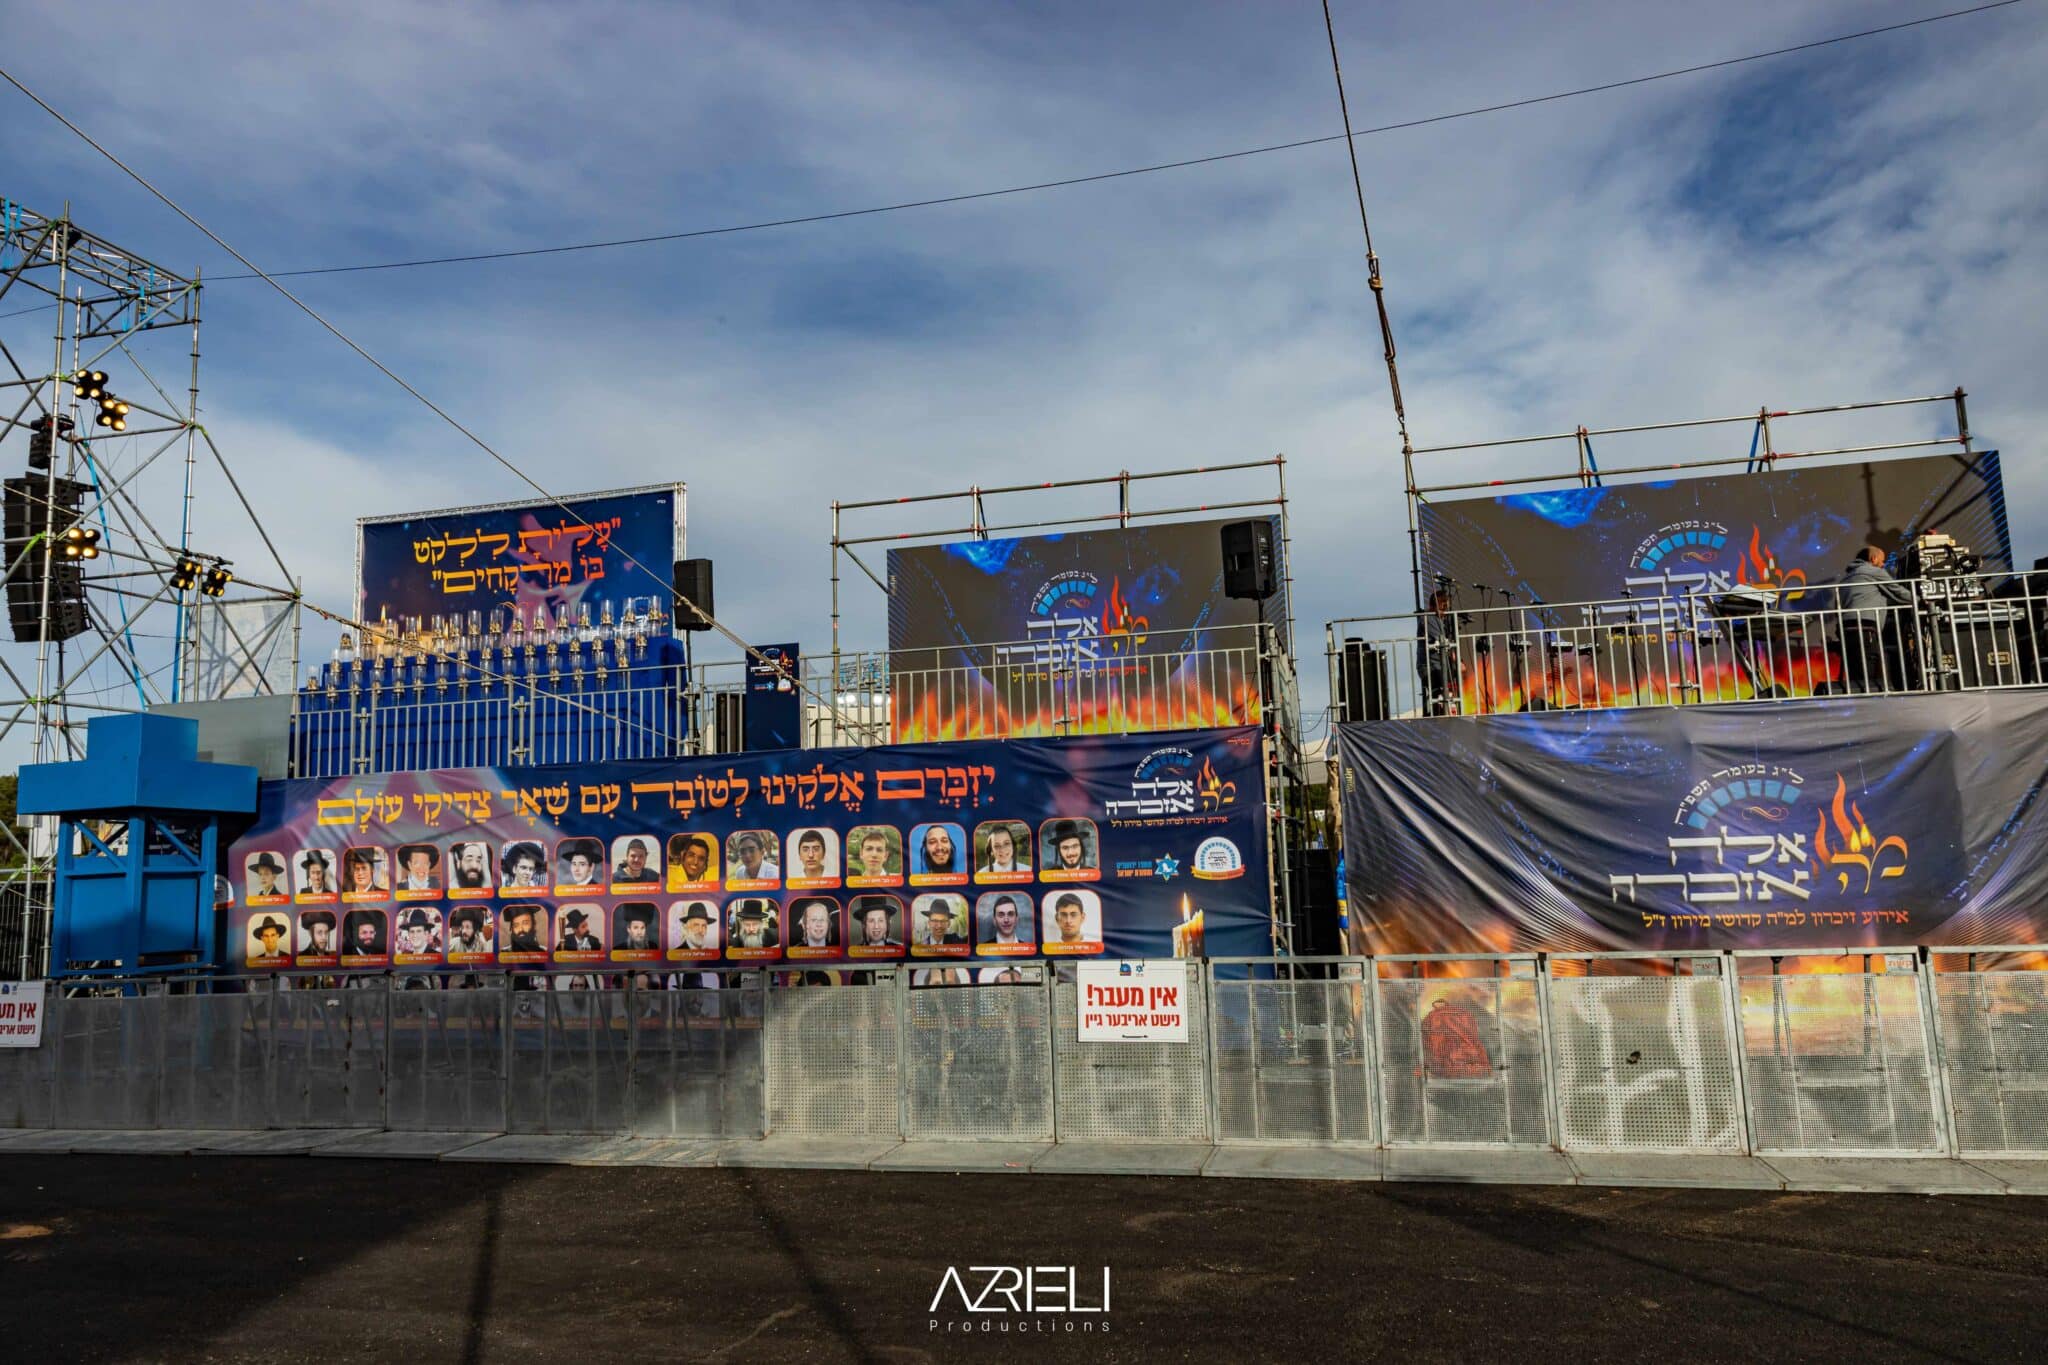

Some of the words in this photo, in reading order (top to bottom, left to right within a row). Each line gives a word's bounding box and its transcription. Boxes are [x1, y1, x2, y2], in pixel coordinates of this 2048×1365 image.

[1624, 567, 1731, 597] אלה
[1027, 612, 1098, 640] אלה
[1712, 764, 1766, 779] בעומר
[1131, 777, 1194, 797] אלה
[1105, 797, 1194, 816] אזכרה
[1667, 826, 1807, 868] אלה
[1609, 869, 1811, 903] אזכרה
[1641, 912, 1666, 929] ז"ל
[1671, 912, 1712, 929] מירון
[1715, 913, 1762, 929] קדושי
[1766, 908, 1807, 927] למ"ה
[1810, 910, 1857, 928] זיכרון
[1862, 908, 1909, 927] אירוע
[1087, 984, 1144, 1007] מעבר!
[1149, 987, 1177, 1010] אין
[18, 1002, 37, 1021] אין
[1085, 1014, 1103, 1028] גיין
[1106, 1014, 1147, 1026] אריבער
[1151, 1014, 1180, 1026] נישט
[17, 1024, 36, 1035] נישט
